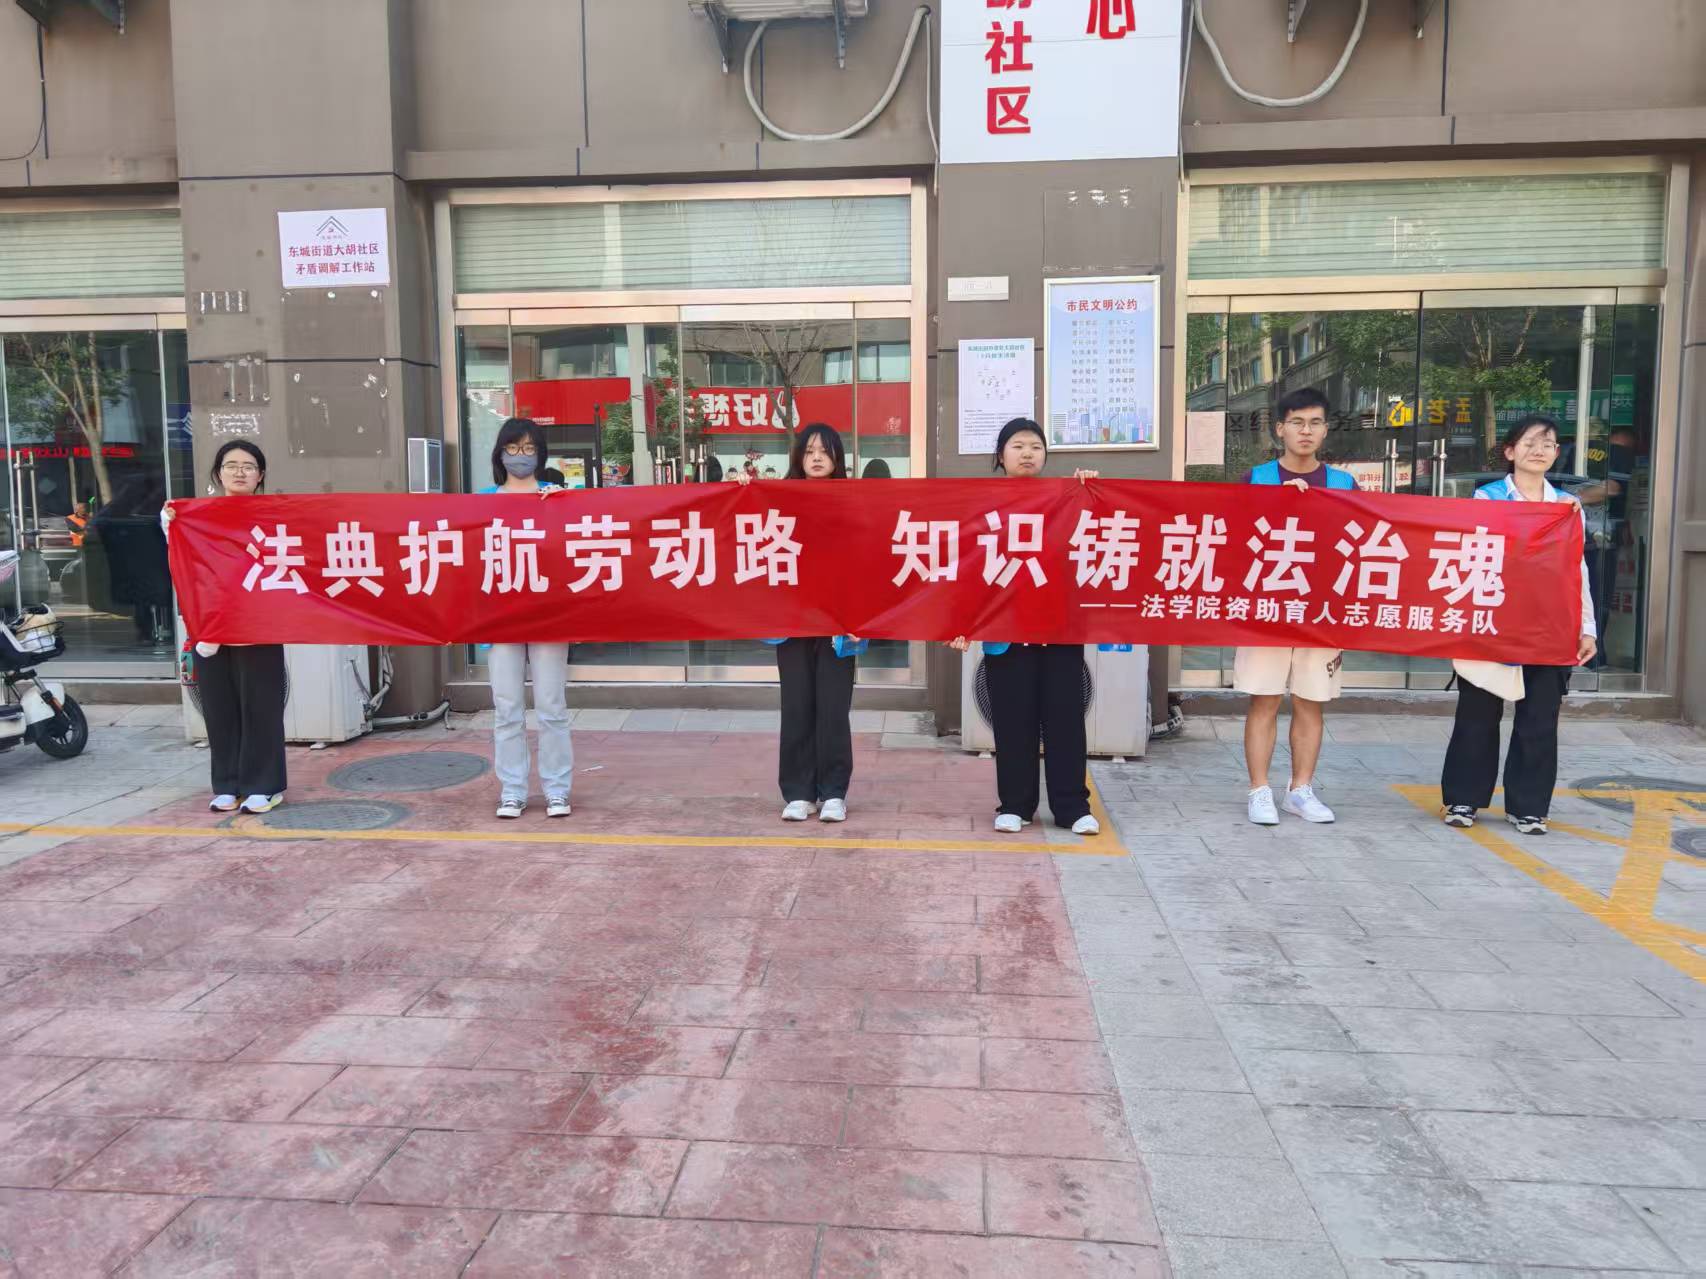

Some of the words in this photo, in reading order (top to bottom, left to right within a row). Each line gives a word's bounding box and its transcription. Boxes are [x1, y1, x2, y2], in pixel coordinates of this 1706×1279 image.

[1086, 0, 1137, 40] 心
[985, 0, 1034, 135] 社区
[288, 243, 380, 258] 东城街道大胡社区
[296, 261, 375, 275] 矛盾调解工作站
[1066, 299, 1137, 312] 市民文明公约
[242, 508, 803, 598] 法典护航劳动路
[891, 509, 1506, 607] 知识铸就法治魂
